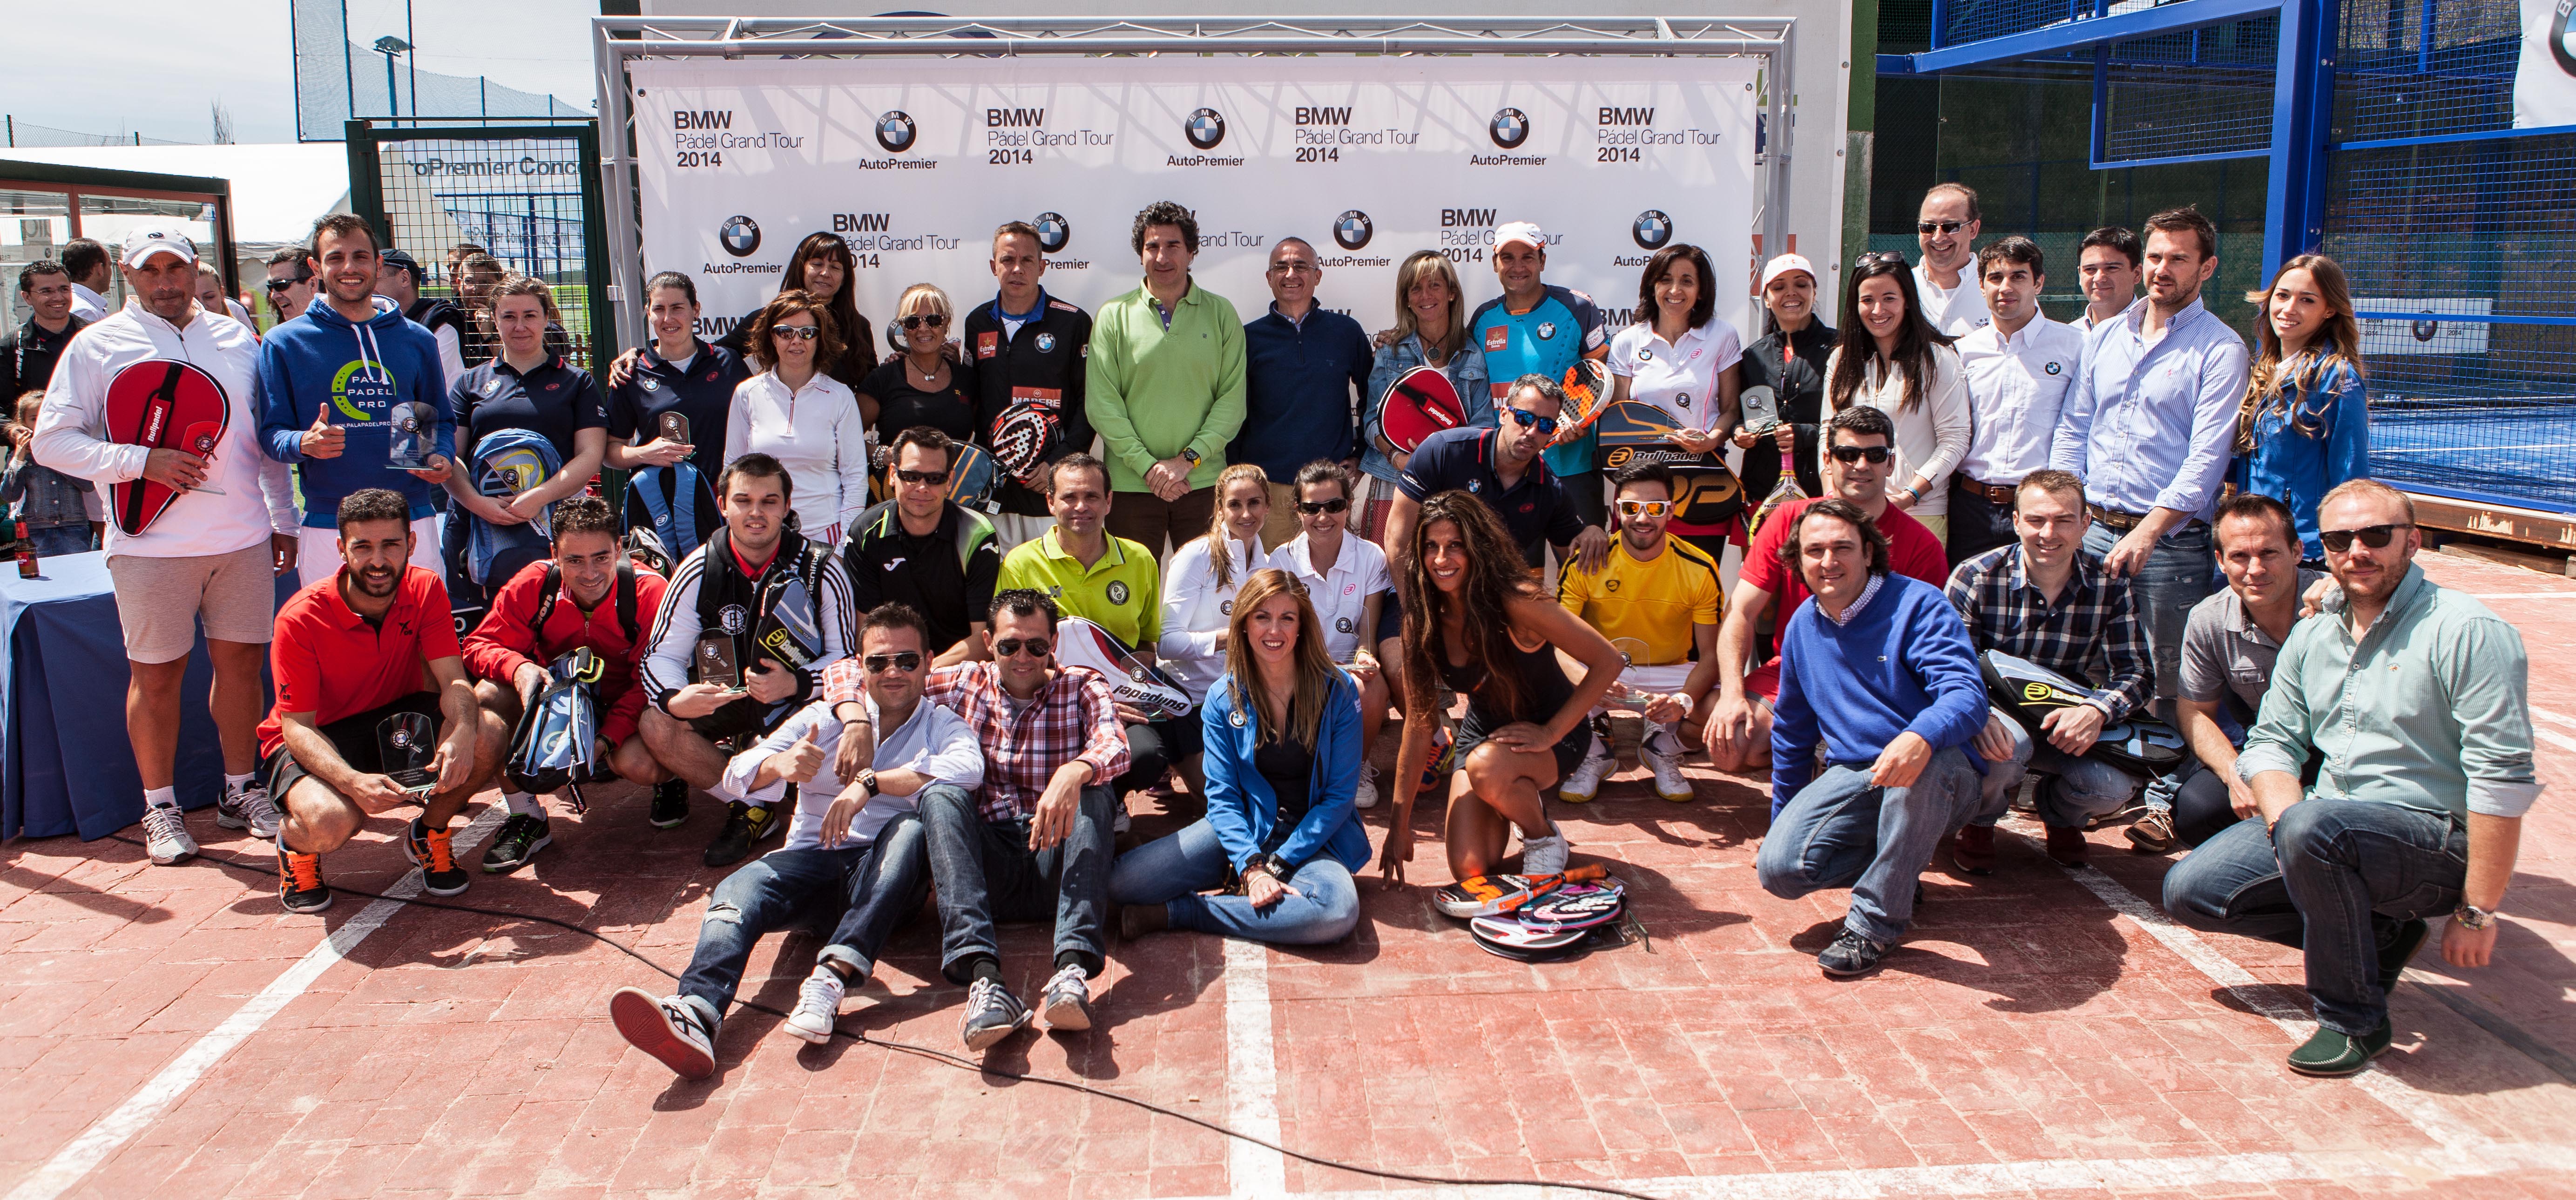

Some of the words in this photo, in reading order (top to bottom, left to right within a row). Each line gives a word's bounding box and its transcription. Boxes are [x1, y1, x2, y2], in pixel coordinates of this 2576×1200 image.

[674, 111, 732, 129] BMW
[987, 108, 1044, 127] BMW
[1295, 107, 1352, 125] BMW
[1598, 108, 1654, 125] BMW
[676, 133, 717, 149] Pádel
[721, 133, 766, 148] Grand
[769, 133, 804, 148] Tour
[988, 130, 1028, 147] Pádel
[1032, 130, 1076, 146] Grand
[1080, 129, 1114, 146] Tour
[1296, 129, 1335, 145] Pádel
[1339, 129, 1383, 144] Grand
[1386, 129, 1420, 144] Tour
[1598, 129, 1637, 144] Pádel
[1641, 129, 1684, 144] Grand
[1688, 129, 1720, 144] Tour
[677, 152, 722, 167] 2014
[989, 149, 1033, 165] 2014
[1167, 155, 1245, 167] AutoPremier
[1295, 147, 1339, 163] 2014
[1470, 155, 1547, 166] AutoPremier
[1597, 147, 1640, 162] 2014
[859, 159, 938, 169] AutoPremier
[833, 214, 890, 232] BMW
[1441, 209, 1497, 227] BMW
[879, 235, 923, 251] Grand
[926, 235, 960, 250] Tour
[1231, 232, 1264, 246] Tour
[1441, 230, 1480, 245] Pádel
[1317, 256, 1391, 267] AutoPremier
[1441, 248, 1483, 263] 2014
[703, 262, 783, 275] AutoPremier
[148, 406, 163, 442] Bullpadel
[1428, 406, 1453, 426] Bullpadel
[1631, 450, 1704, 462] Bullpadel
[778, 638, 810, 666] Bullpad
[1112, 684, 1189, 711] Bullpadel
